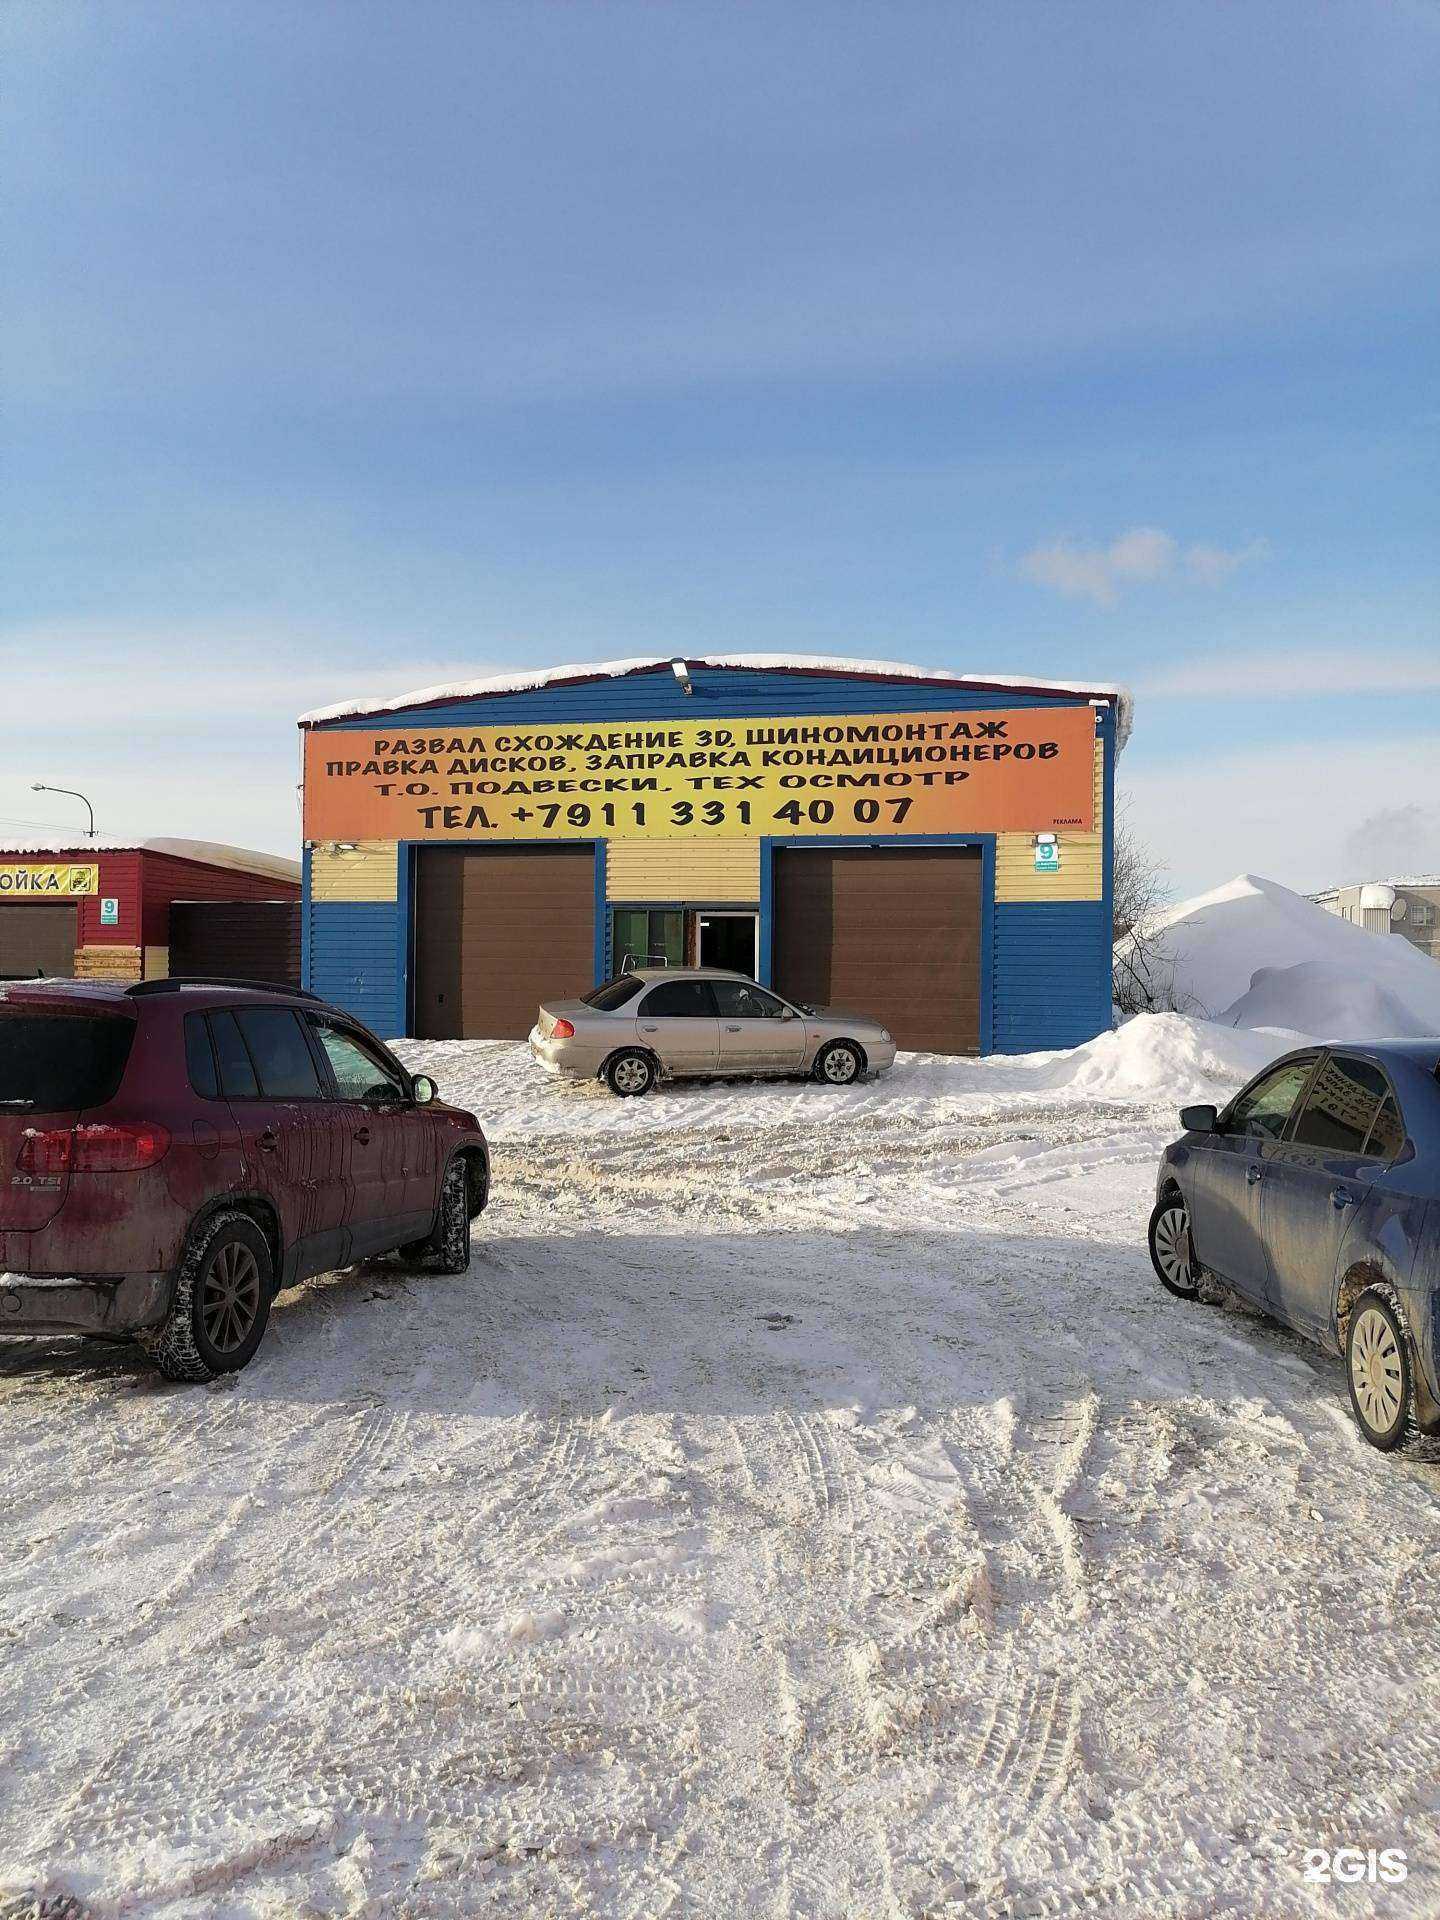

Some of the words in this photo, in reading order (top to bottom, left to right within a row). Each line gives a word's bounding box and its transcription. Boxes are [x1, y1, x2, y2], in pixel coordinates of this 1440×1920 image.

[374, 738, 487, 756] РАЗВАЛ
[494, 731, 684, 753] СХОЖДЕНИЕ
[694, 729, 736, 748] 3D,
[745, 720, 1009, 745] ШИНОМОНТАЖ
[326, 758, 440, 777] ПРАВКА
[446, 754, 577, 774] ДИСКОВ,
[585, 749, 752, 770] ЗАПРАВКА
[762, 742, 1060, 767] КОНДИЦИОНЕРОВ
[373, 782, 439, 797] Т.О.
[449, 776, 673, 796] ПОДВЕСКИ,
[684, 775, 766, 791] ТЕХ
[778, 771, 970, 790] ОСМОТР
[416, 804, 499, 830] ТЕЛ.
[510, 800, 646, 829] +7911
[669, 799, 752, 827] 331
[772, 799, 836, 826] 40
[852, 796, 914, 825] 07
[1052, 817, 1084, 825] РЕКЛАМА
[1039, 843, 1054, 860] 9
[104, 899, 115, 914] 9
[10, 1176, 33, 1185] 2.0
[38, 1176, 62, 1185] TSI
